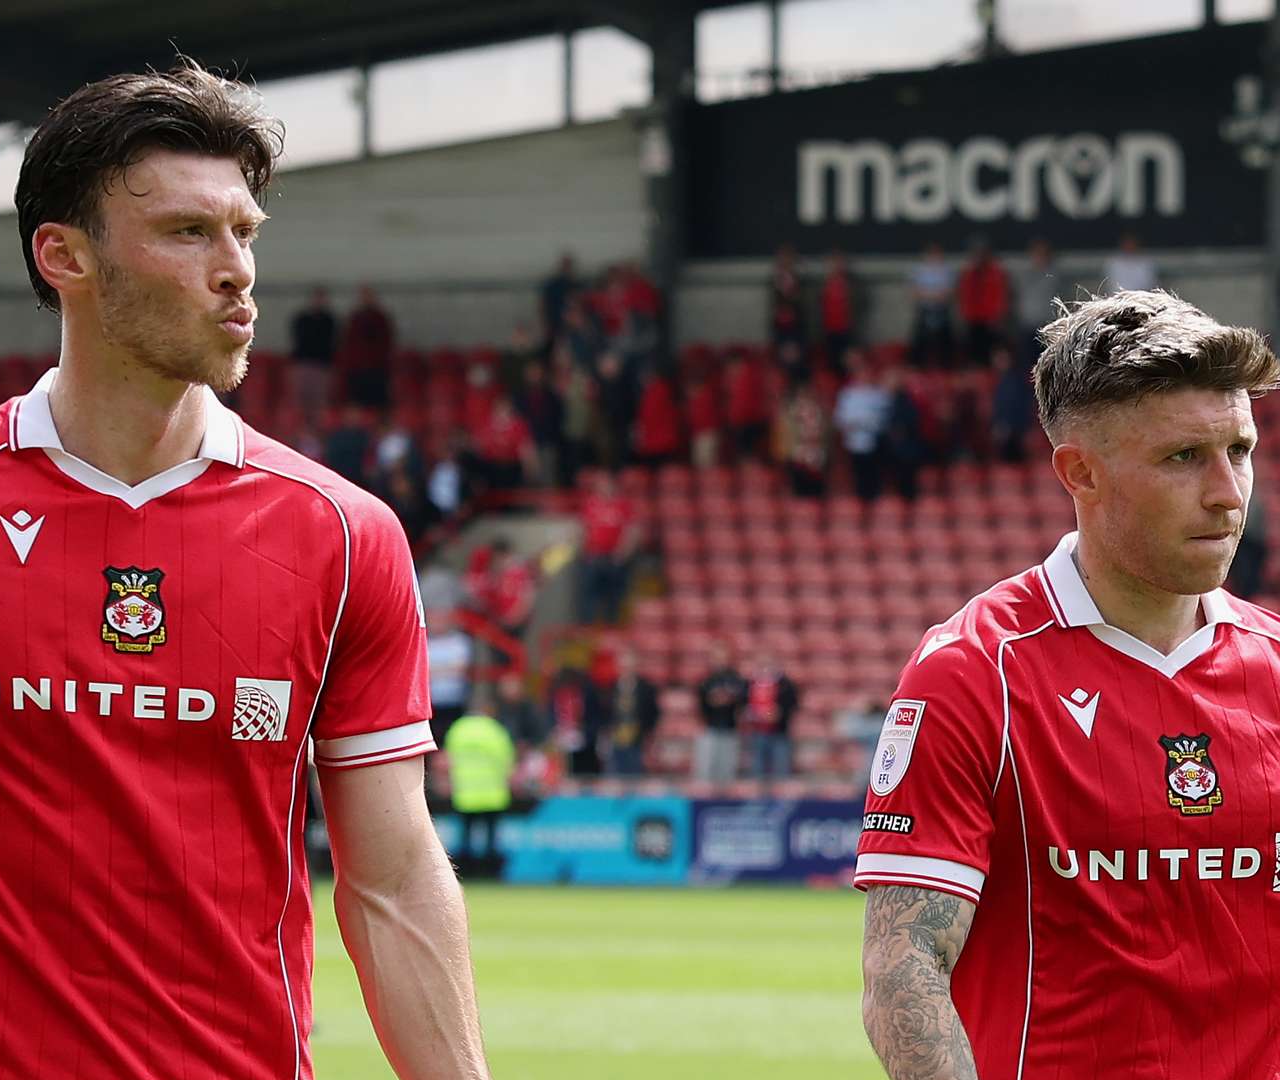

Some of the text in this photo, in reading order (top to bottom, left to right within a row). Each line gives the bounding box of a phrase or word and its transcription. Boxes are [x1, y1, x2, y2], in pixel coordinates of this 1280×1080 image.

[797, 133, 1186, 224] macron
[896, 708, 915, 722] bet
[878, 773, 890, 784] EFL
[863, 813, 912, 833] GETHER
[1048, 846, 1262, 881] UNITED
